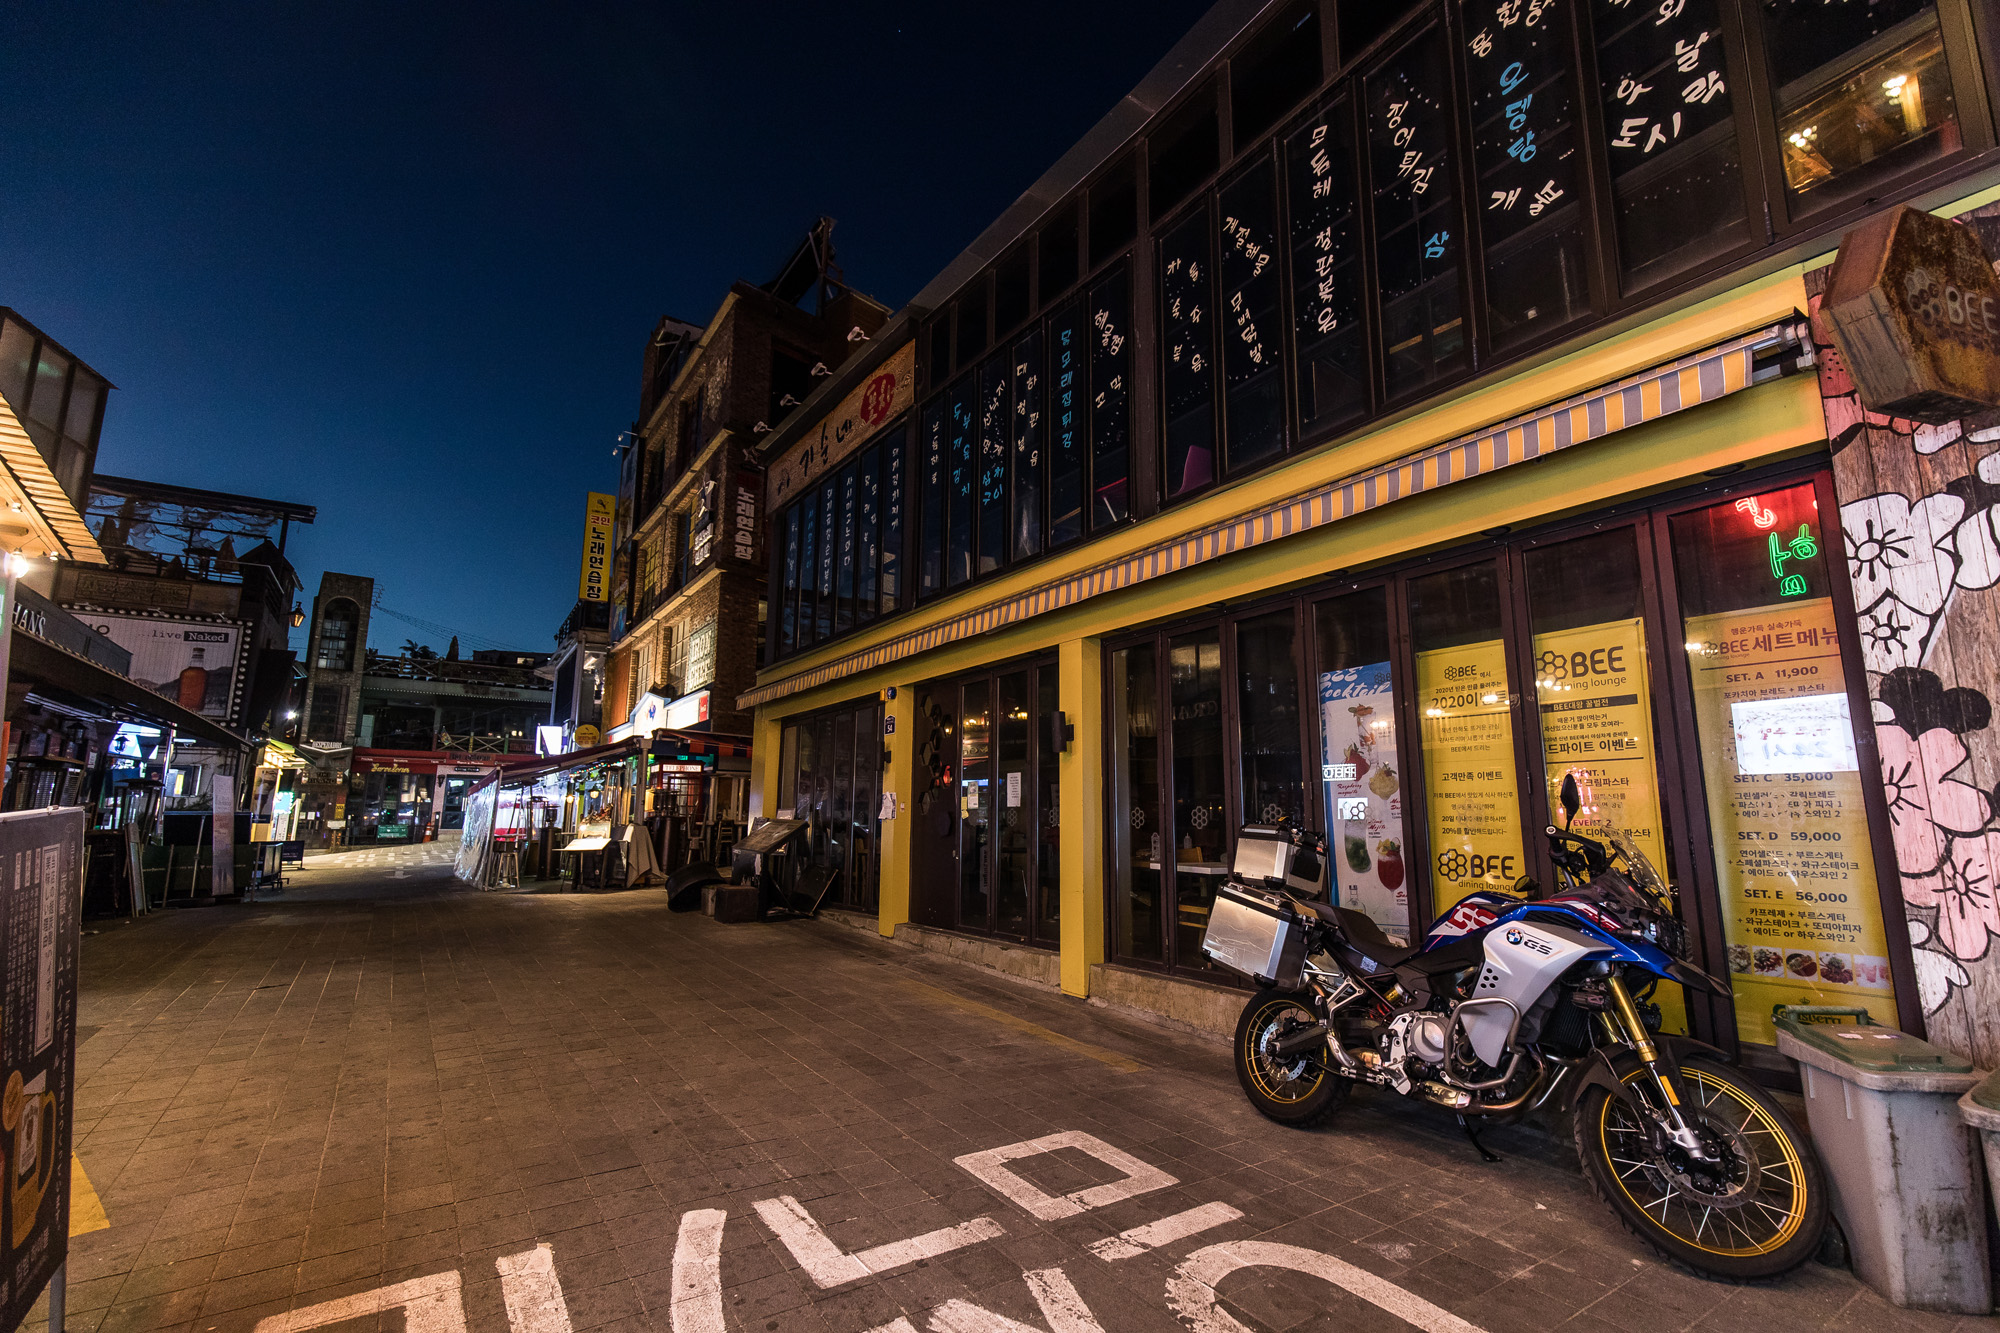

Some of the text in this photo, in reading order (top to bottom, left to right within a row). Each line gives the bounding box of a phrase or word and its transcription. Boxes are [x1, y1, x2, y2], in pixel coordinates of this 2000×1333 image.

[1500, 61, 1537, 163] 오뎅탕
[1945, 285, 1999, 334] BEE
[591, 516, 610, 526] 코인
[735, 487, 754, 560] 노래연습장
[586, 527, 605, 599] 노래연습장
[187, 632, 225, 642] Naked
[1720, 628, 1839, 654] BEE 세트메뉴
[1571, 646, 1626, 678] BEE
[1458, 665, 1477, 677] BEE
[1726, 666, 1819, 683] SET. A 11,900
[1591, 677, 1626, 688] lounge
[1724, 690, 1757, 700] 포카치아
[1760, 687, 1786, 696] 브레드
[1798, 684, 1825, 692] 파스타
[1587, 721, 1599, 729] 모두
[1599, 739, 1637, 752] 이벤트
[1442, 771, 1503, 781] 고객만족 이벤트
[1585, 777, 1629, 787] 크림파스타
[1733, 772, 1833, 783] SET. C 35,000
[1815, 801, 1834, 809] 피자
[1738, 832, 1841, 843] SET. D 59,000
[1470, 854, 1515, 880] BEE
[1801, 861, 1860, 870] 와규스테이크
[1748, 868, 1774, 877] 에이드
[1791, 870, 1838, 879] 하우스와인
[1458, 880, 1483, 891] dining
[1744, 889, 1848, 903] SET. E 56,000
[1750, 908, 1846, 922] 카프레제 부르스게타
[1745, 918, 1862, 933] 와규스테이크 또띠아피자
[1753, 928, 1781, 937] 에이드
[1797, 931, 1845, 942] 하우스와인
[1524, 939, 1553, 955] GS
